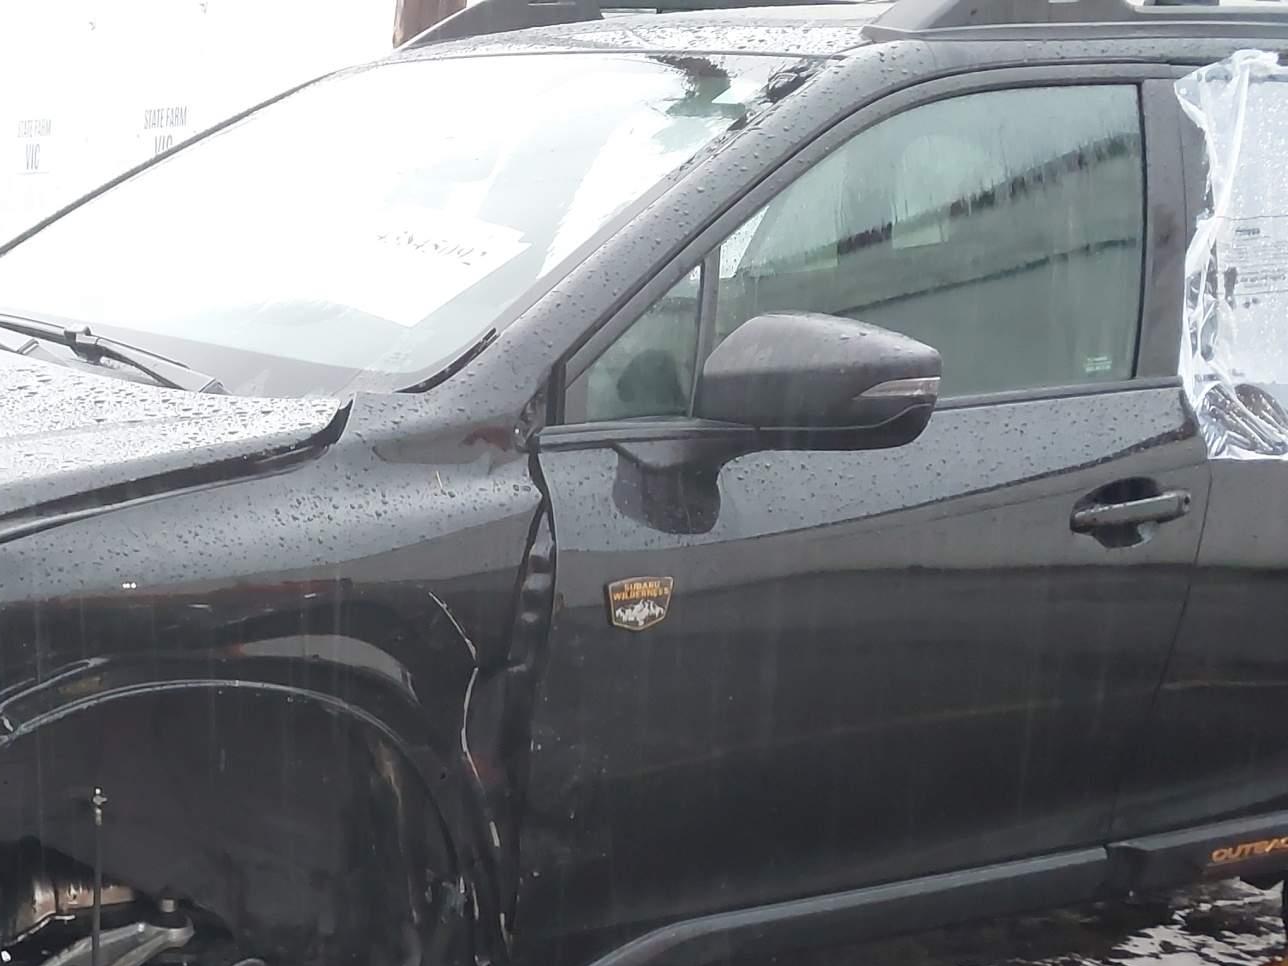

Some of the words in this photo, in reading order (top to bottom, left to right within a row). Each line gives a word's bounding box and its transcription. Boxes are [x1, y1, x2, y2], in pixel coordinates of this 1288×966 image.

[144, 108, 164, 129] STATE
[166, 106, 187, 128] FARM
[17, 120, 33, 138] STATE
[34, 119, 52, 136] FARM
[25, 144, 40, 170] VIC
[613, 587, 669, 601] WILDERNESS
[624, 581, 660, 592] SUBARU
